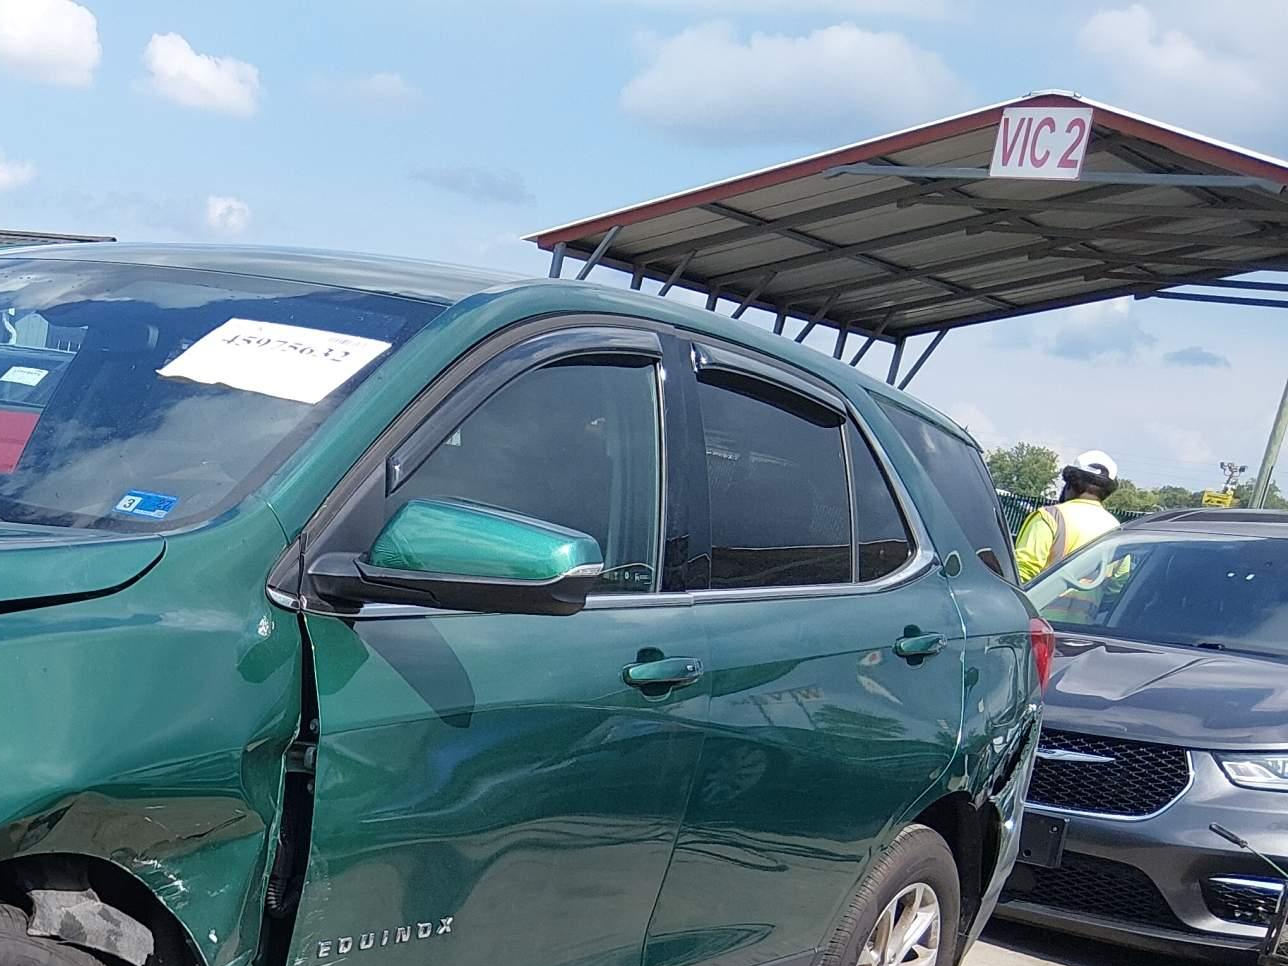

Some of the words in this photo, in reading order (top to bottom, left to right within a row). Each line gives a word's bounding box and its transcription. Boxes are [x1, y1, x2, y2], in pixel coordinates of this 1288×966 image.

[1001, 116, 1056, 169] VIC
[1057, 117, 1086, 169] 2
[123, 498, 136, 508] 3
[316, 915, 455, 958] EQUINOX
